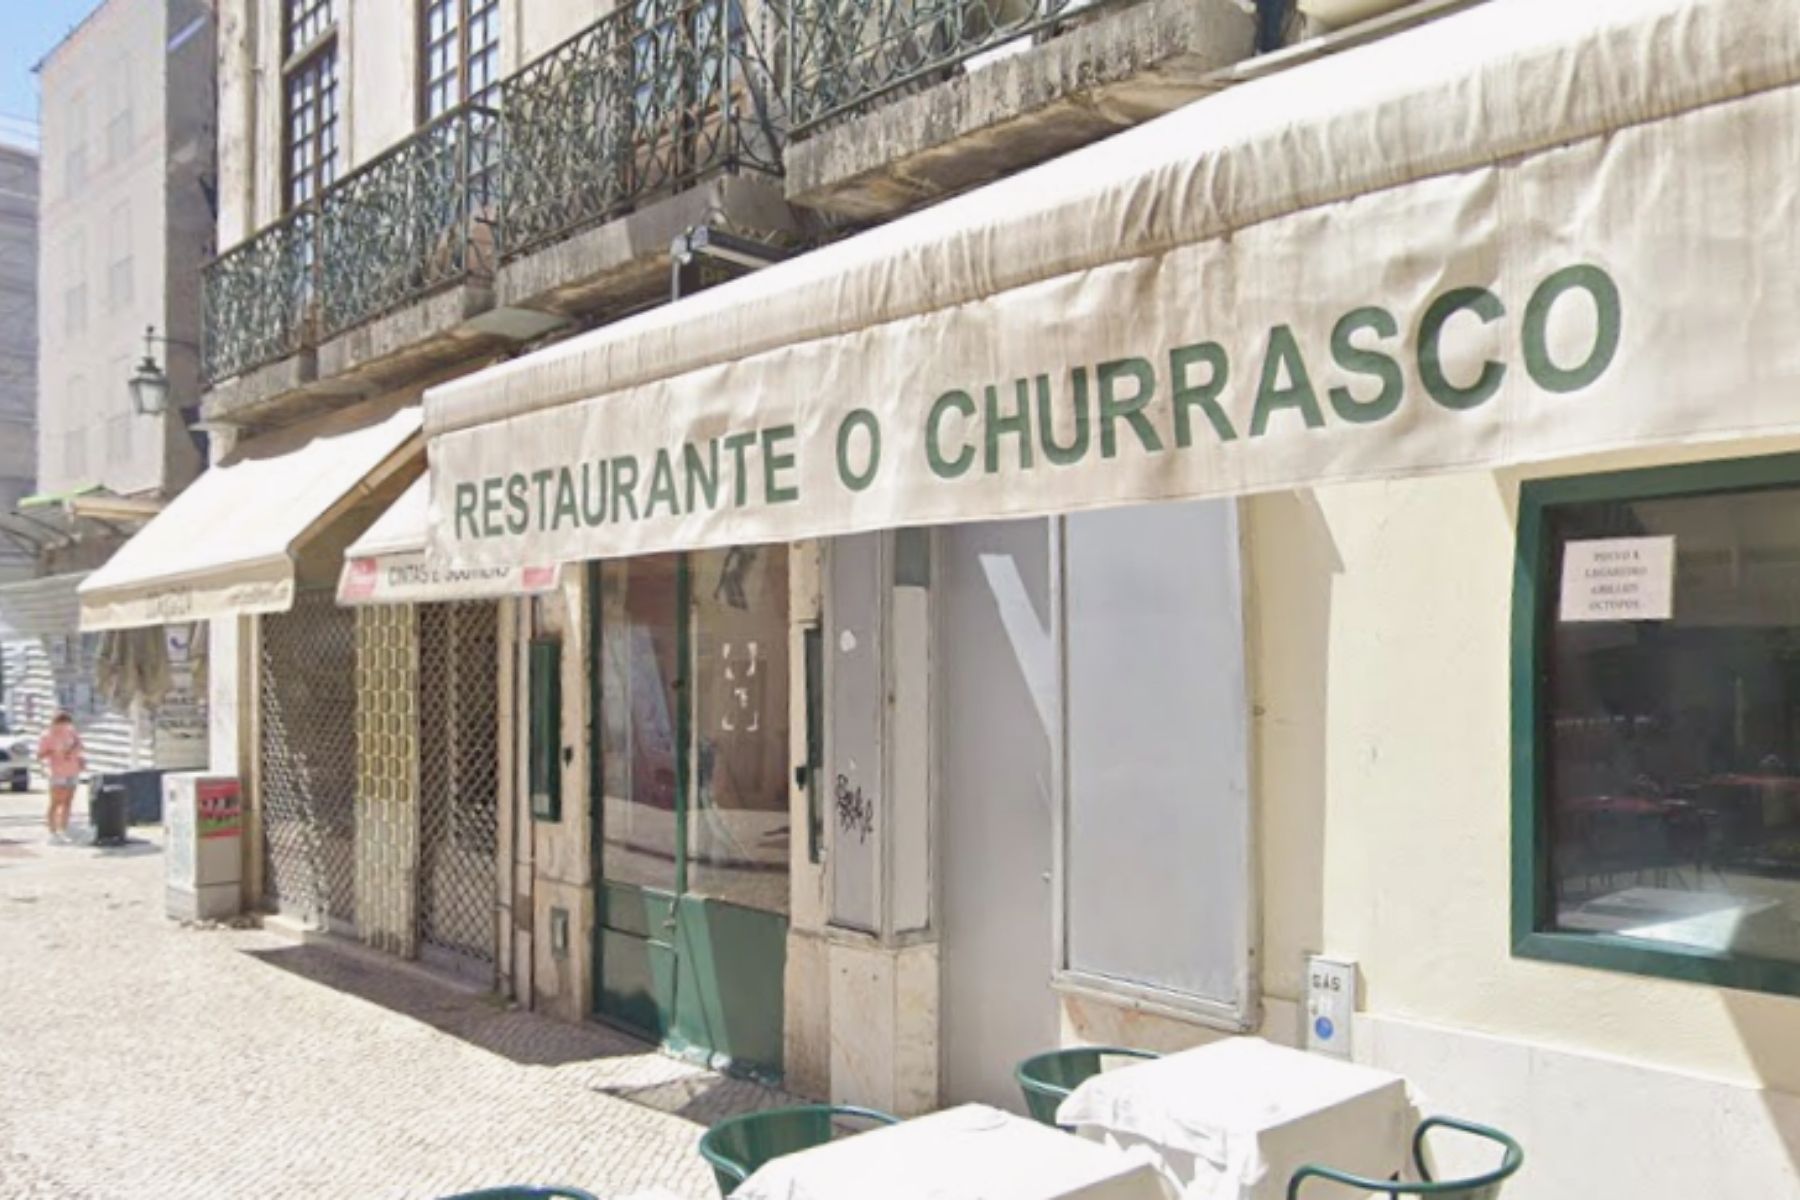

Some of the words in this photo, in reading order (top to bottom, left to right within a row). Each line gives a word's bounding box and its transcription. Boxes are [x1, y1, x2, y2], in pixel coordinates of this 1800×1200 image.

[454, 424, 799, 540] RESTAURANTE
[836, 407, 881, 492] O
[925, 263, 1622, 479] CHURRASCO
